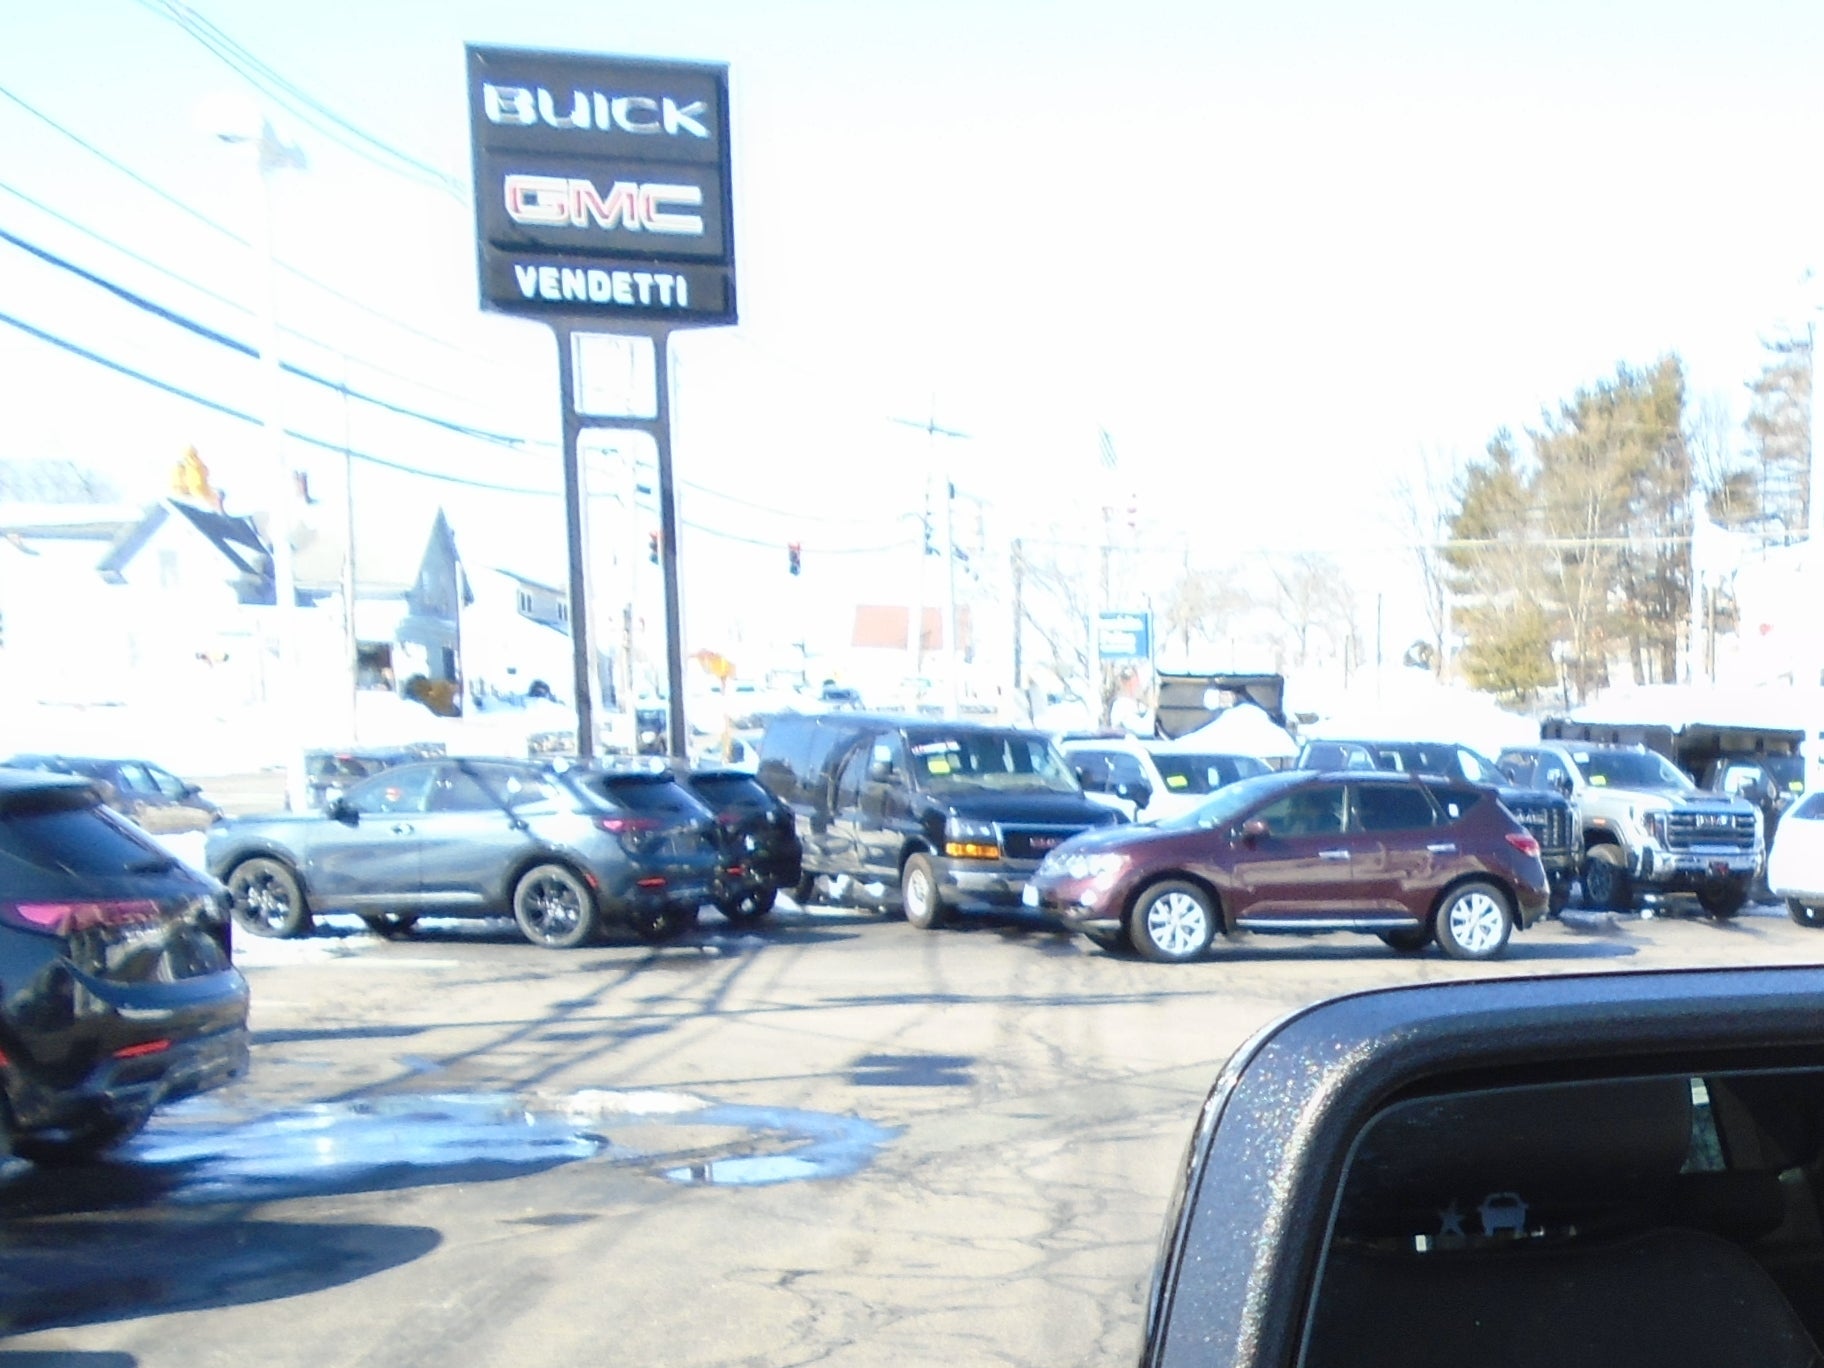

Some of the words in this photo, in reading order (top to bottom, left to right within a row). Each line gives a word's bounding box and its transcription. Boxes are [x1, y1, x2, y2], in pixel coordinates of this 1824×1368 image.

[482, 82, 711, 138] BUICK
[504, 174, 703, 236] GMC
[514, 264, 688, 307] VENDETTI
